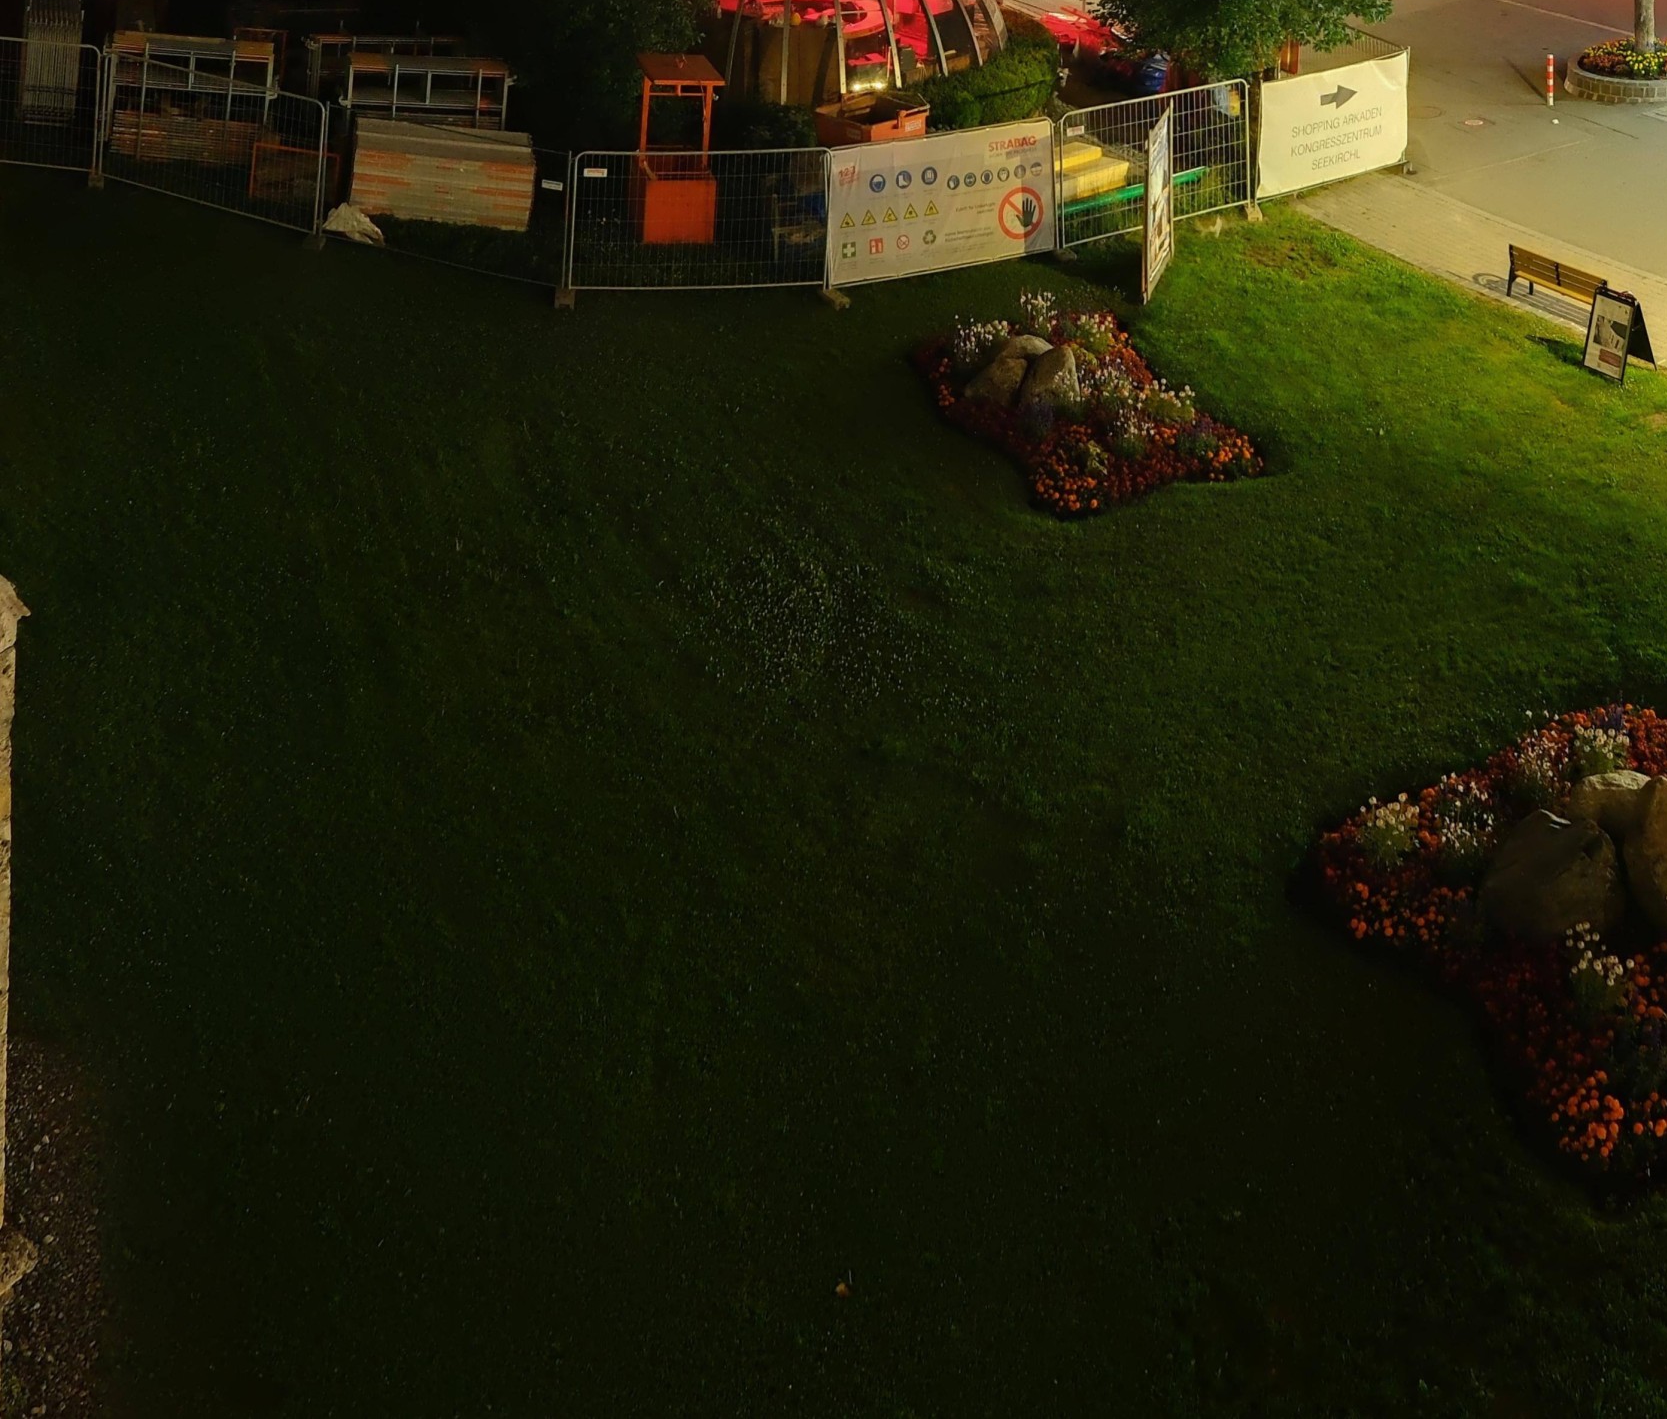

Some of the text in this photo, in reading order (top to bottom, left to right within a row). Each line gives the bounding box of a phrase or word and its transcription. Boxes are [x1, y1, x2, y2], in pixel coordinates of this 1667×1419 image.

[1291, 107, 1384, 139] SHOPPING ARKADEN
[989, 136, 1037, 152] STRABAG
[1290, 126, 1384, 158] KONGRESSZENTRUM
[1311, 148, 1361, 171] SEEKIRCHL
